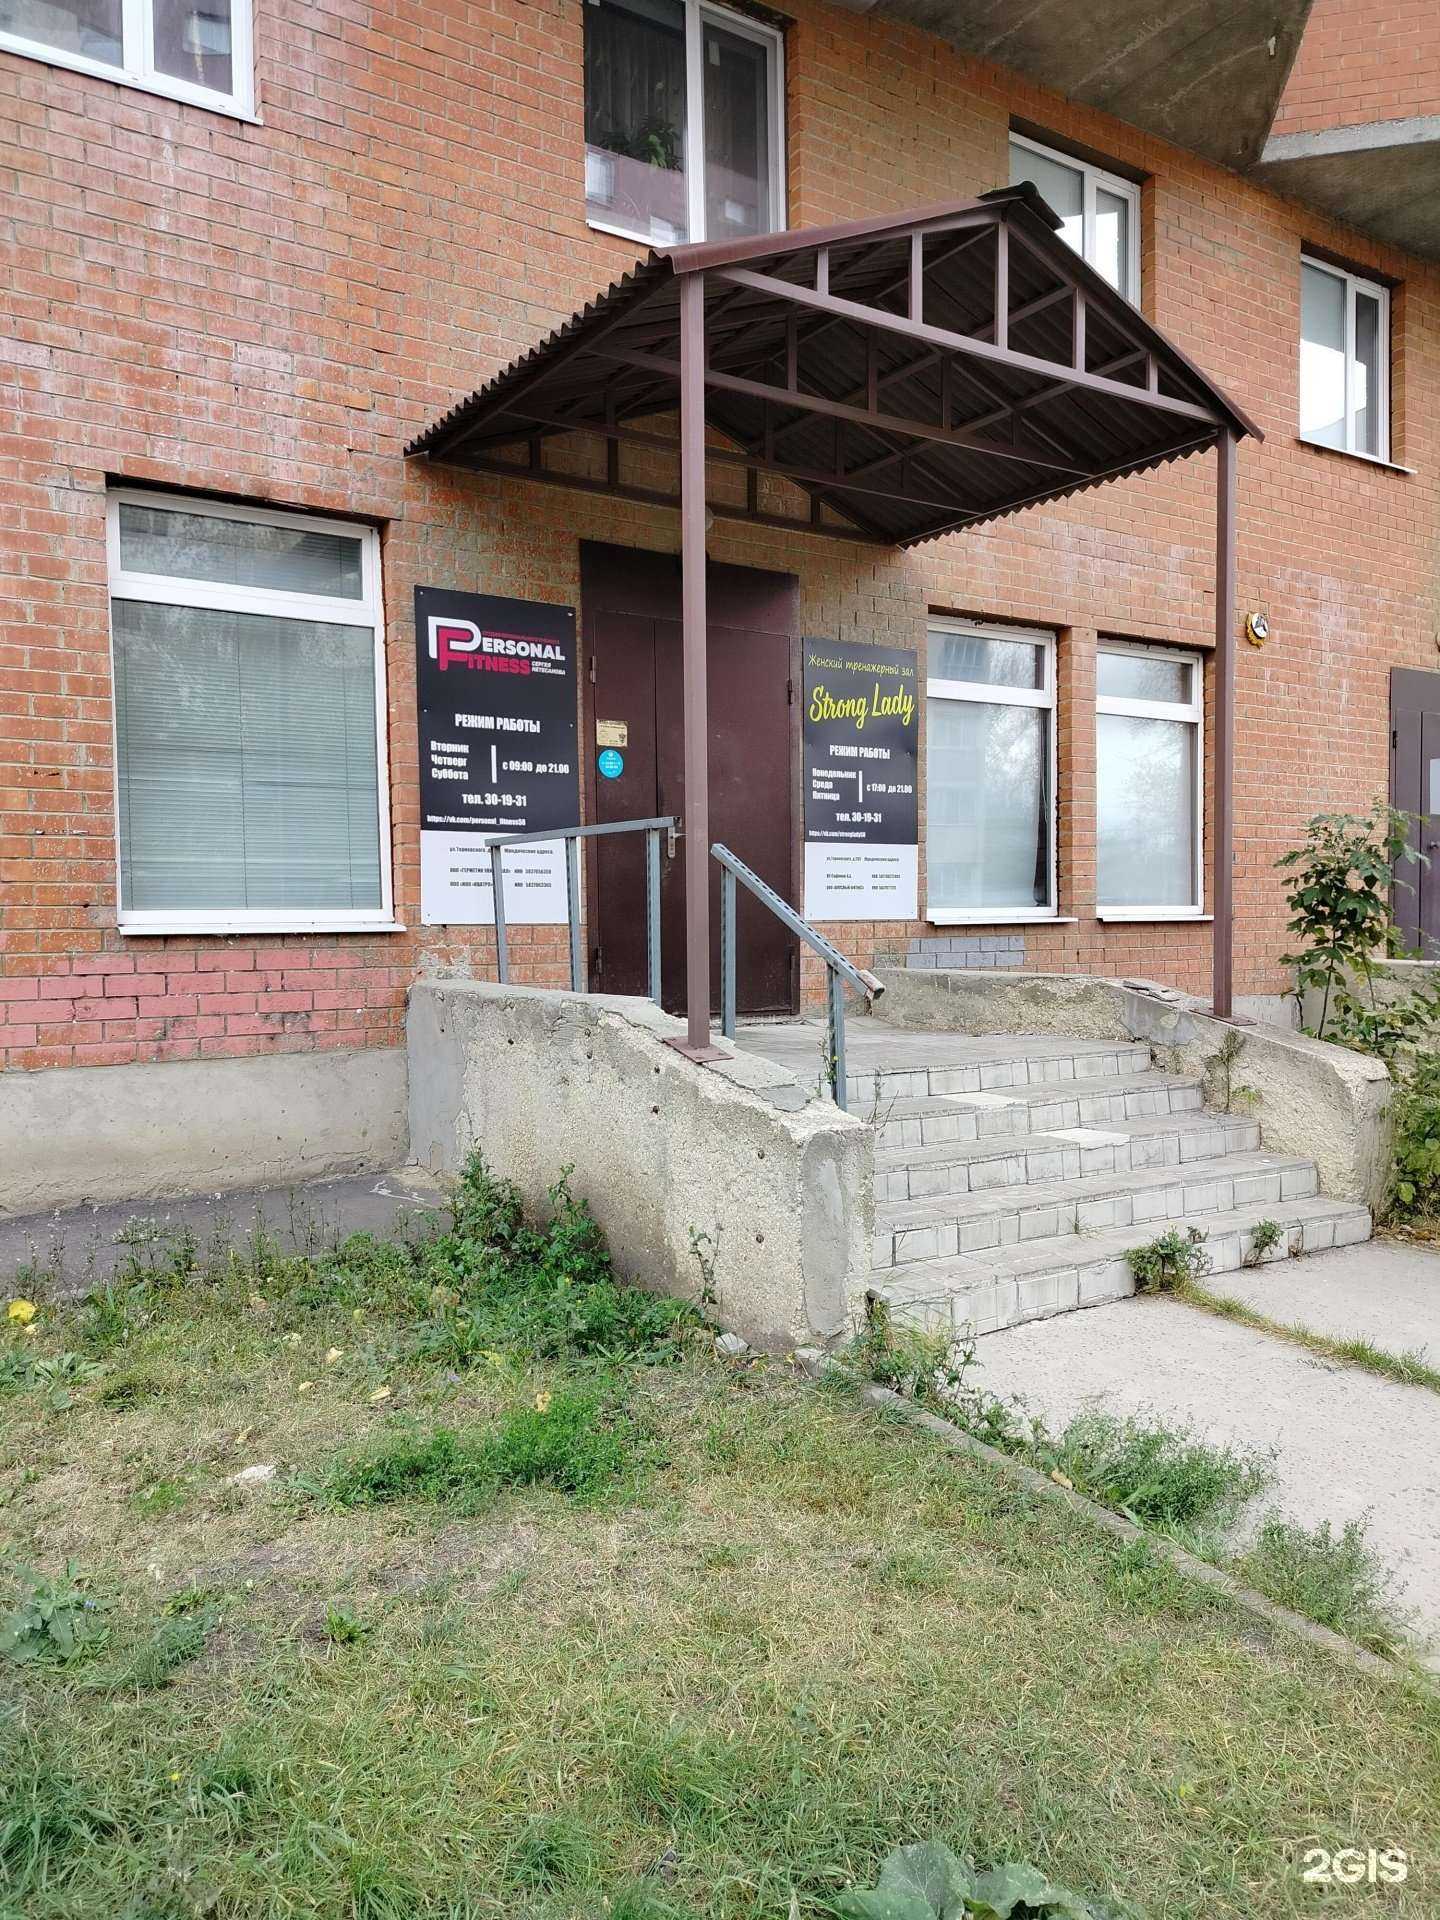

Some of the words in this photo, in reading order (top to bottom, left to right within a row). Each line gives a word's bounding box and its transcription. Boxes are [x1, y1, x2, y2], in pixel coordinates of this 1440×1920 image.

[428, 616, 566, 661] PERSONAL
[439, 628, 531, 676] FITNESS
[808, 653, 843, 669] Женский
[846, 660, 899, 677] тренажерный
[901, 667, 914, 677] зал
[809, 684, 869, 729] Strong
[871, 682, 915, 726] Lady
[455, 713, 495, 730] РЕЖИМ
[496, 717, 541, 733] РАБОТЫ
[430, 740, 470, 754] Вторник
[829, 744, 858, 757] РЕЖИМ
[859, 747, 891, 760] РАБОТЫ
[431, 754, 467, 767] Четверг
[431, 767, 469, 781] Суббота
[502, 762, 509, 771] с
[509, 761, 533, 773] 09:00
[535, 764, 548, 775] до
[548, 763, 570, 774] 21.00
[812, 768, 857, 779] Понедельник
[812, 779, 833, 790] Среда
[462, 793, 484, 806] тел.
[484, 793, 527, 807] 30-19-31
[812, 790, 840, 801] Пятница
[836, 812, 851, 822] тел.
[851, 811, 882, 823] 30-19-31
